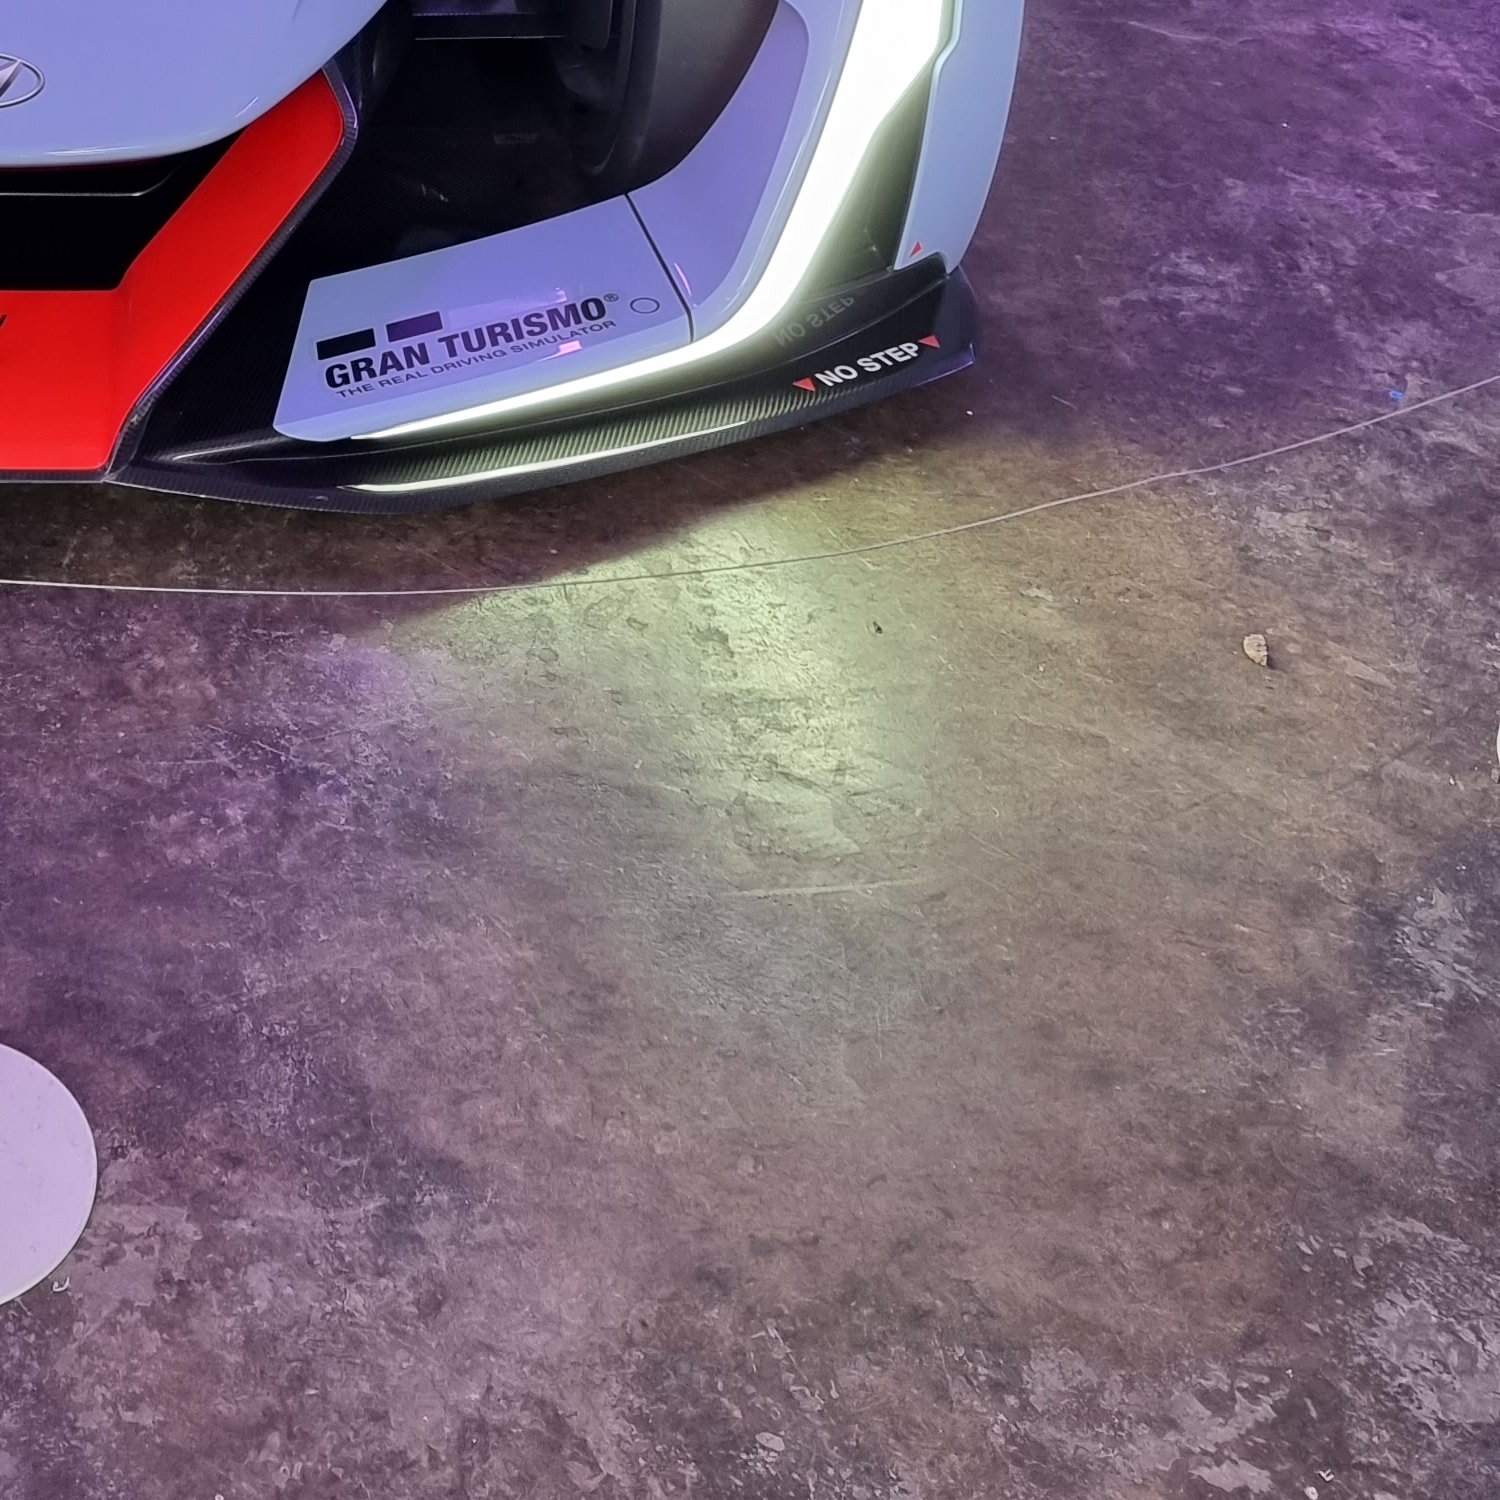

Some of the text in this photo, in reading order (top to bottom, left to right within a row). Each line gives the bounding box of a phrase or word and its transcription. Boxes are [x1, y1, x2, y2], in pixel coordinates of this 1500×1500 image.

[325, 342, 431, 389] GRAN
[336, 320, 617, 398] THE REAL DRIVING SIMULATOR
[814, 342, 920, 387] NO STEP
